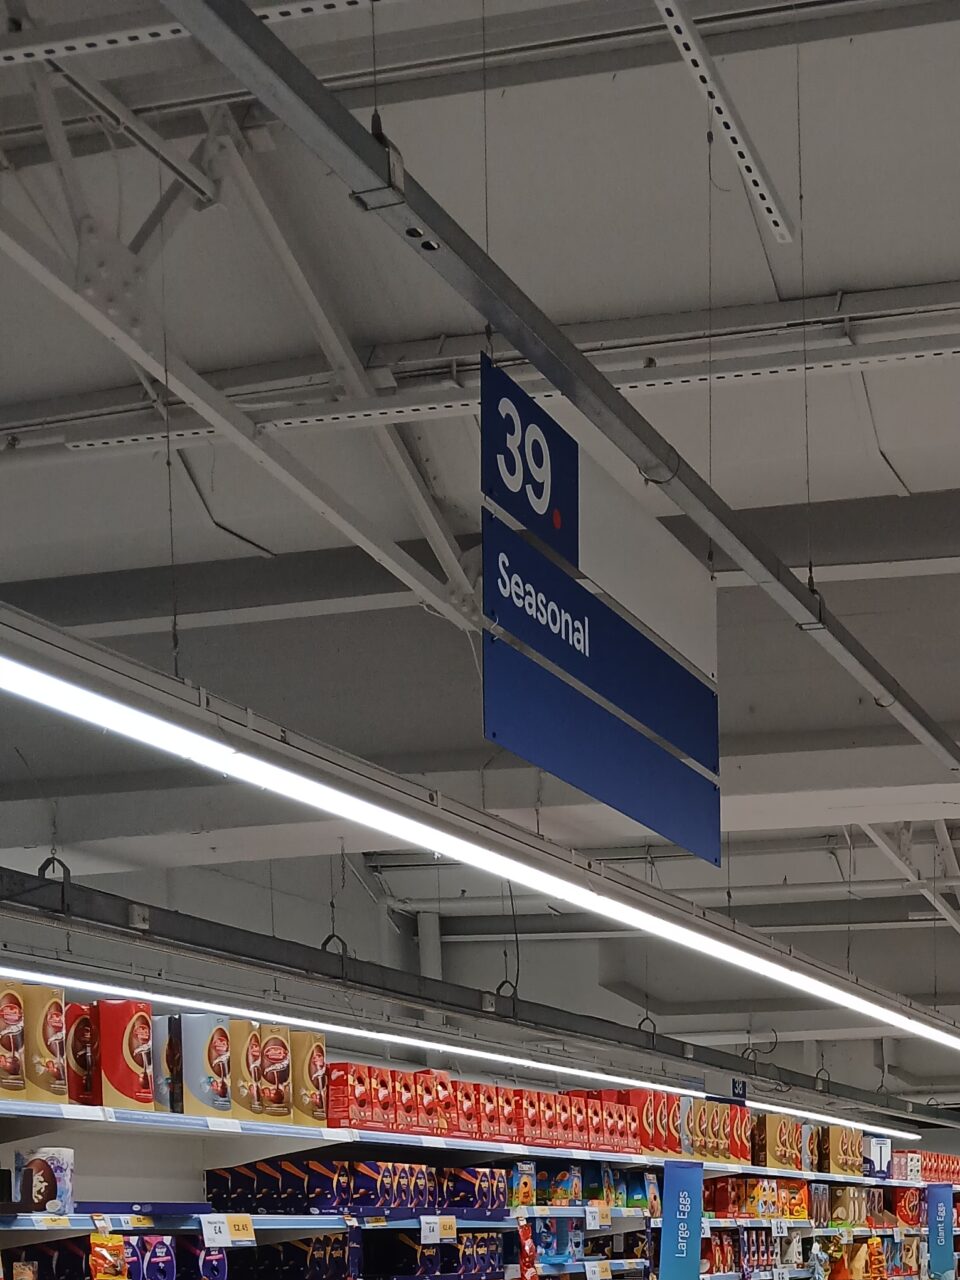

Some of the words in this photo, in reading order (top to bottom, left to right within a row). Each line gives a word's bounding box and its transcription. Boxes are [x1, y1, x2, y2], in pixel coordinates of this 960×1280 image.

[498, 552, 590, 657] Seasonal
[676, 1191, 691, 1219] Eggs
[936, 1202, 946, 1221] Eggs
[213, 1225, 222, 1235] £4
[233, 1223, 249, 1232] £2.45
[675, 1222, 690, 1257] Large
[776, 1221, 784, 1235] £6
[937, 1223, 945, 1246] Giant
